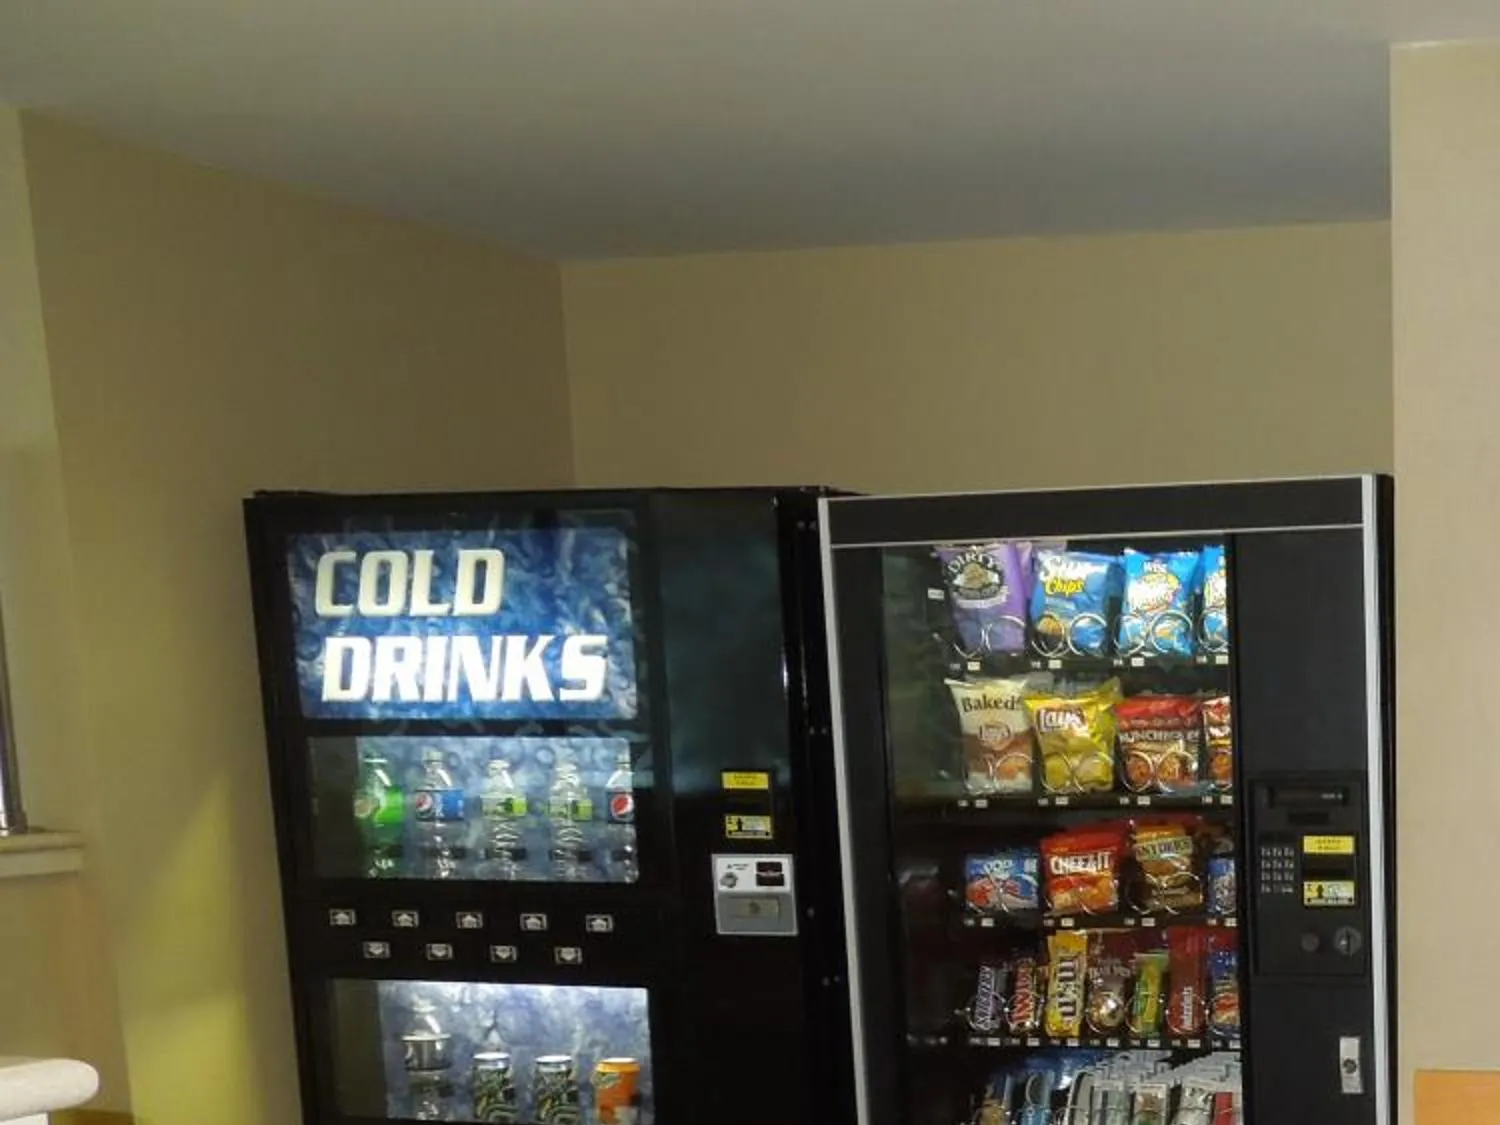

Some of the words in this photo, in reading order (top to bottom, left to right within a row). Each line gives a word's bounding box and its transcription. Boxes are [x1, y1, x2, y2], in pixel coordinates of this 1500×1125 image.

[314, 548, 506, 618] COLD
[1045, 576, 1086, 596] Chips
[321, 634, 608, 702] DRINKS
